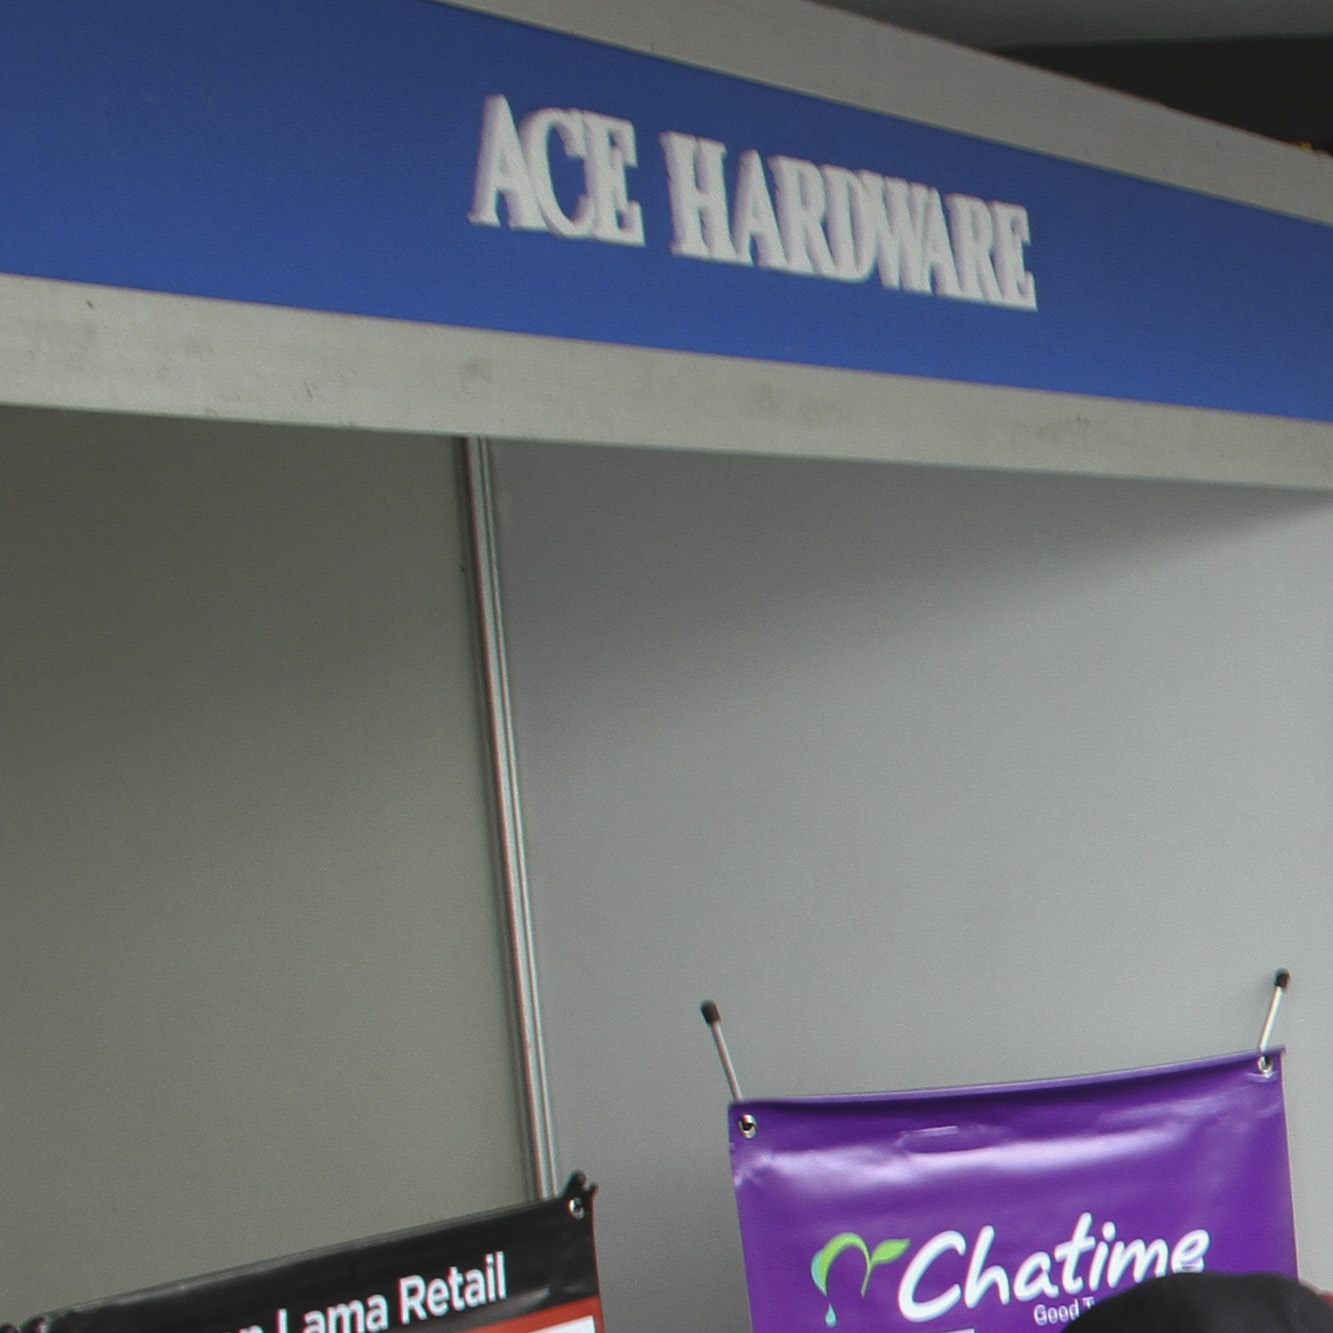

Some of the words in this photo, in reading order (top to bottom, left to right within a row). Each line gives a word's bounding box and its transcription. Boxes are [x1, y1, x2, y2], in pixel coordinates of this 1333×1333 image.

[467, 94, 645, 246] ACE
[659, 131, 1037, 311] HARDWARE
[398, 1251, 508, 1325] Retail
[897, 1211, 1211, 1324] Chatime
[1033, 1297, 1080, 1327] Good
